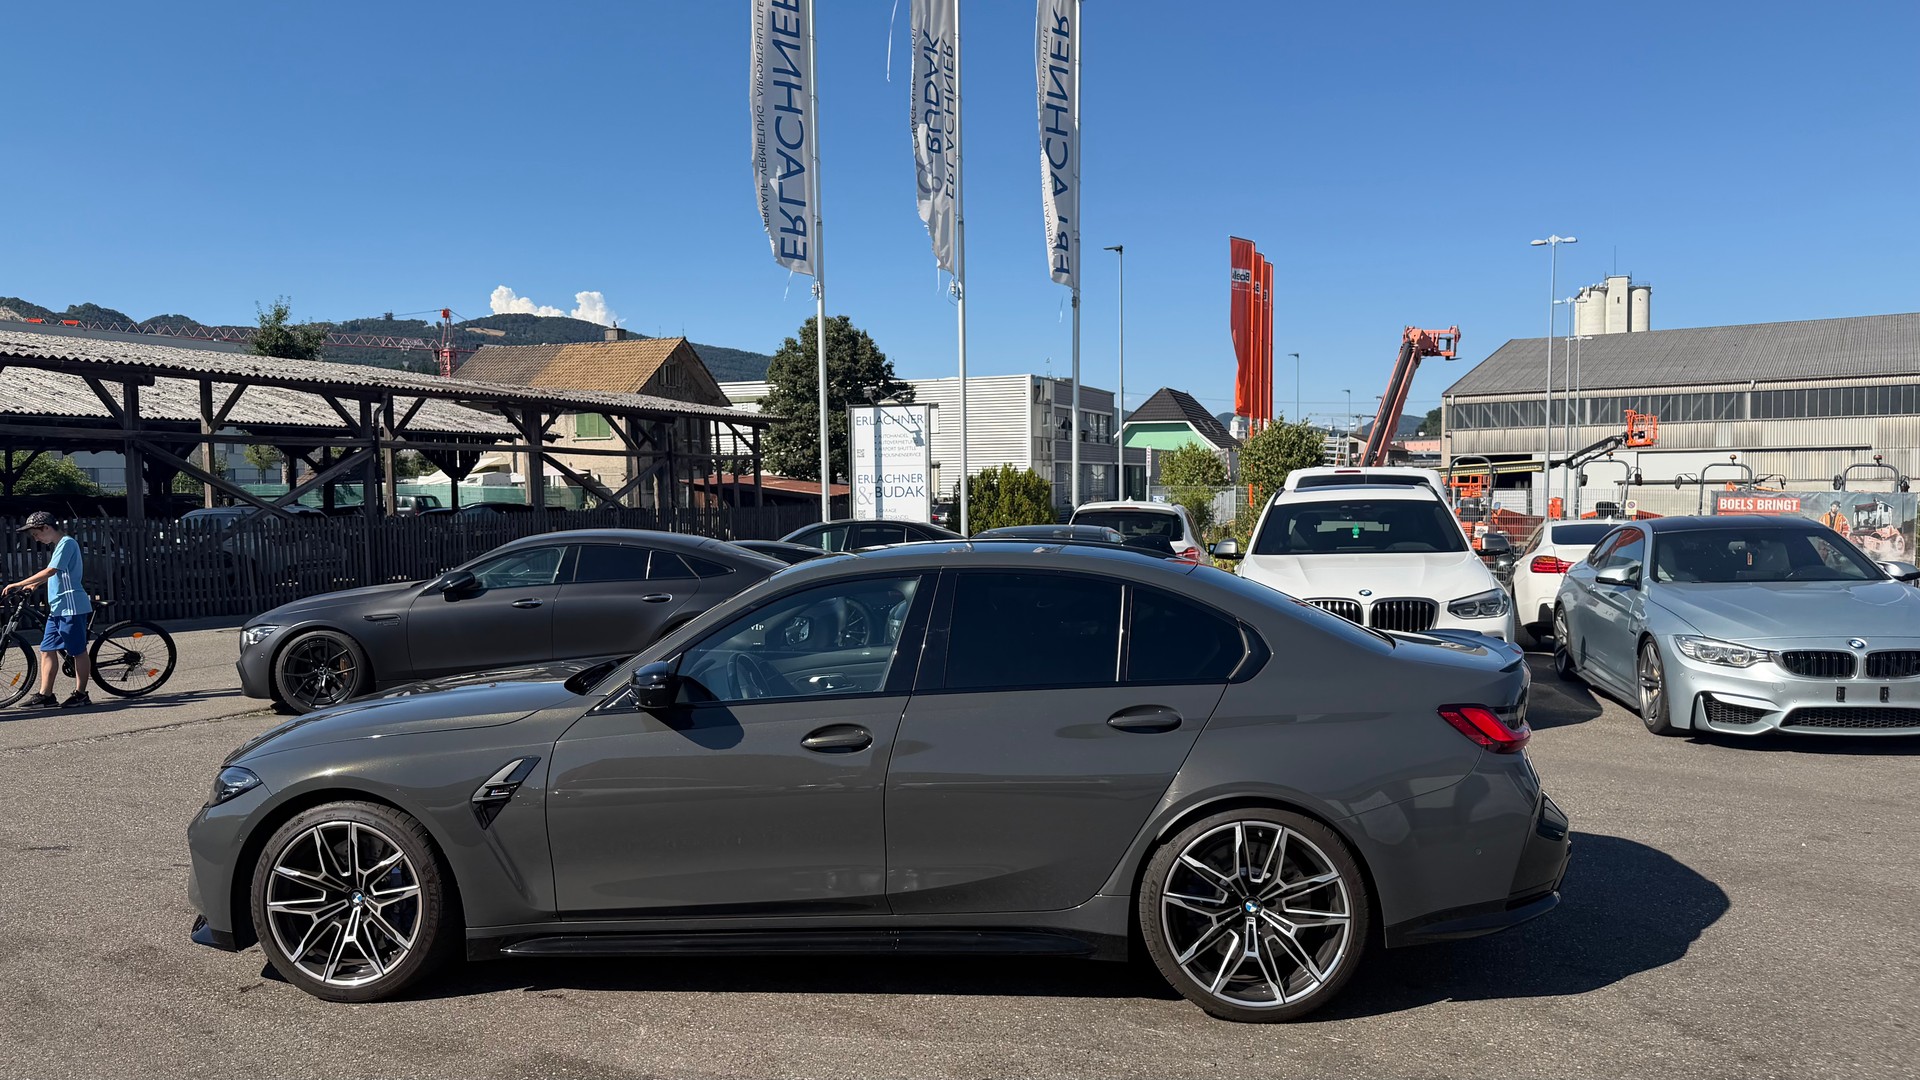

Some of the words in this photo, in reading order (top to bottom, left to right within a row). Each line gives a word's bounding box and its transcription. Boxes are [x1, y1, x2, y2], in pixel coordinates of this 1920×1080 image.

[856, 414, 924, 426] ERLACHNER
[858, 474, 924, 484] ERLACHNER
[858, 486, 874, 505] &
[875, 486, 925, 498] BUDAK
[1720, 499, 1754, 510] BOELS
[1757, 499, 1798, 511] BRINGT
